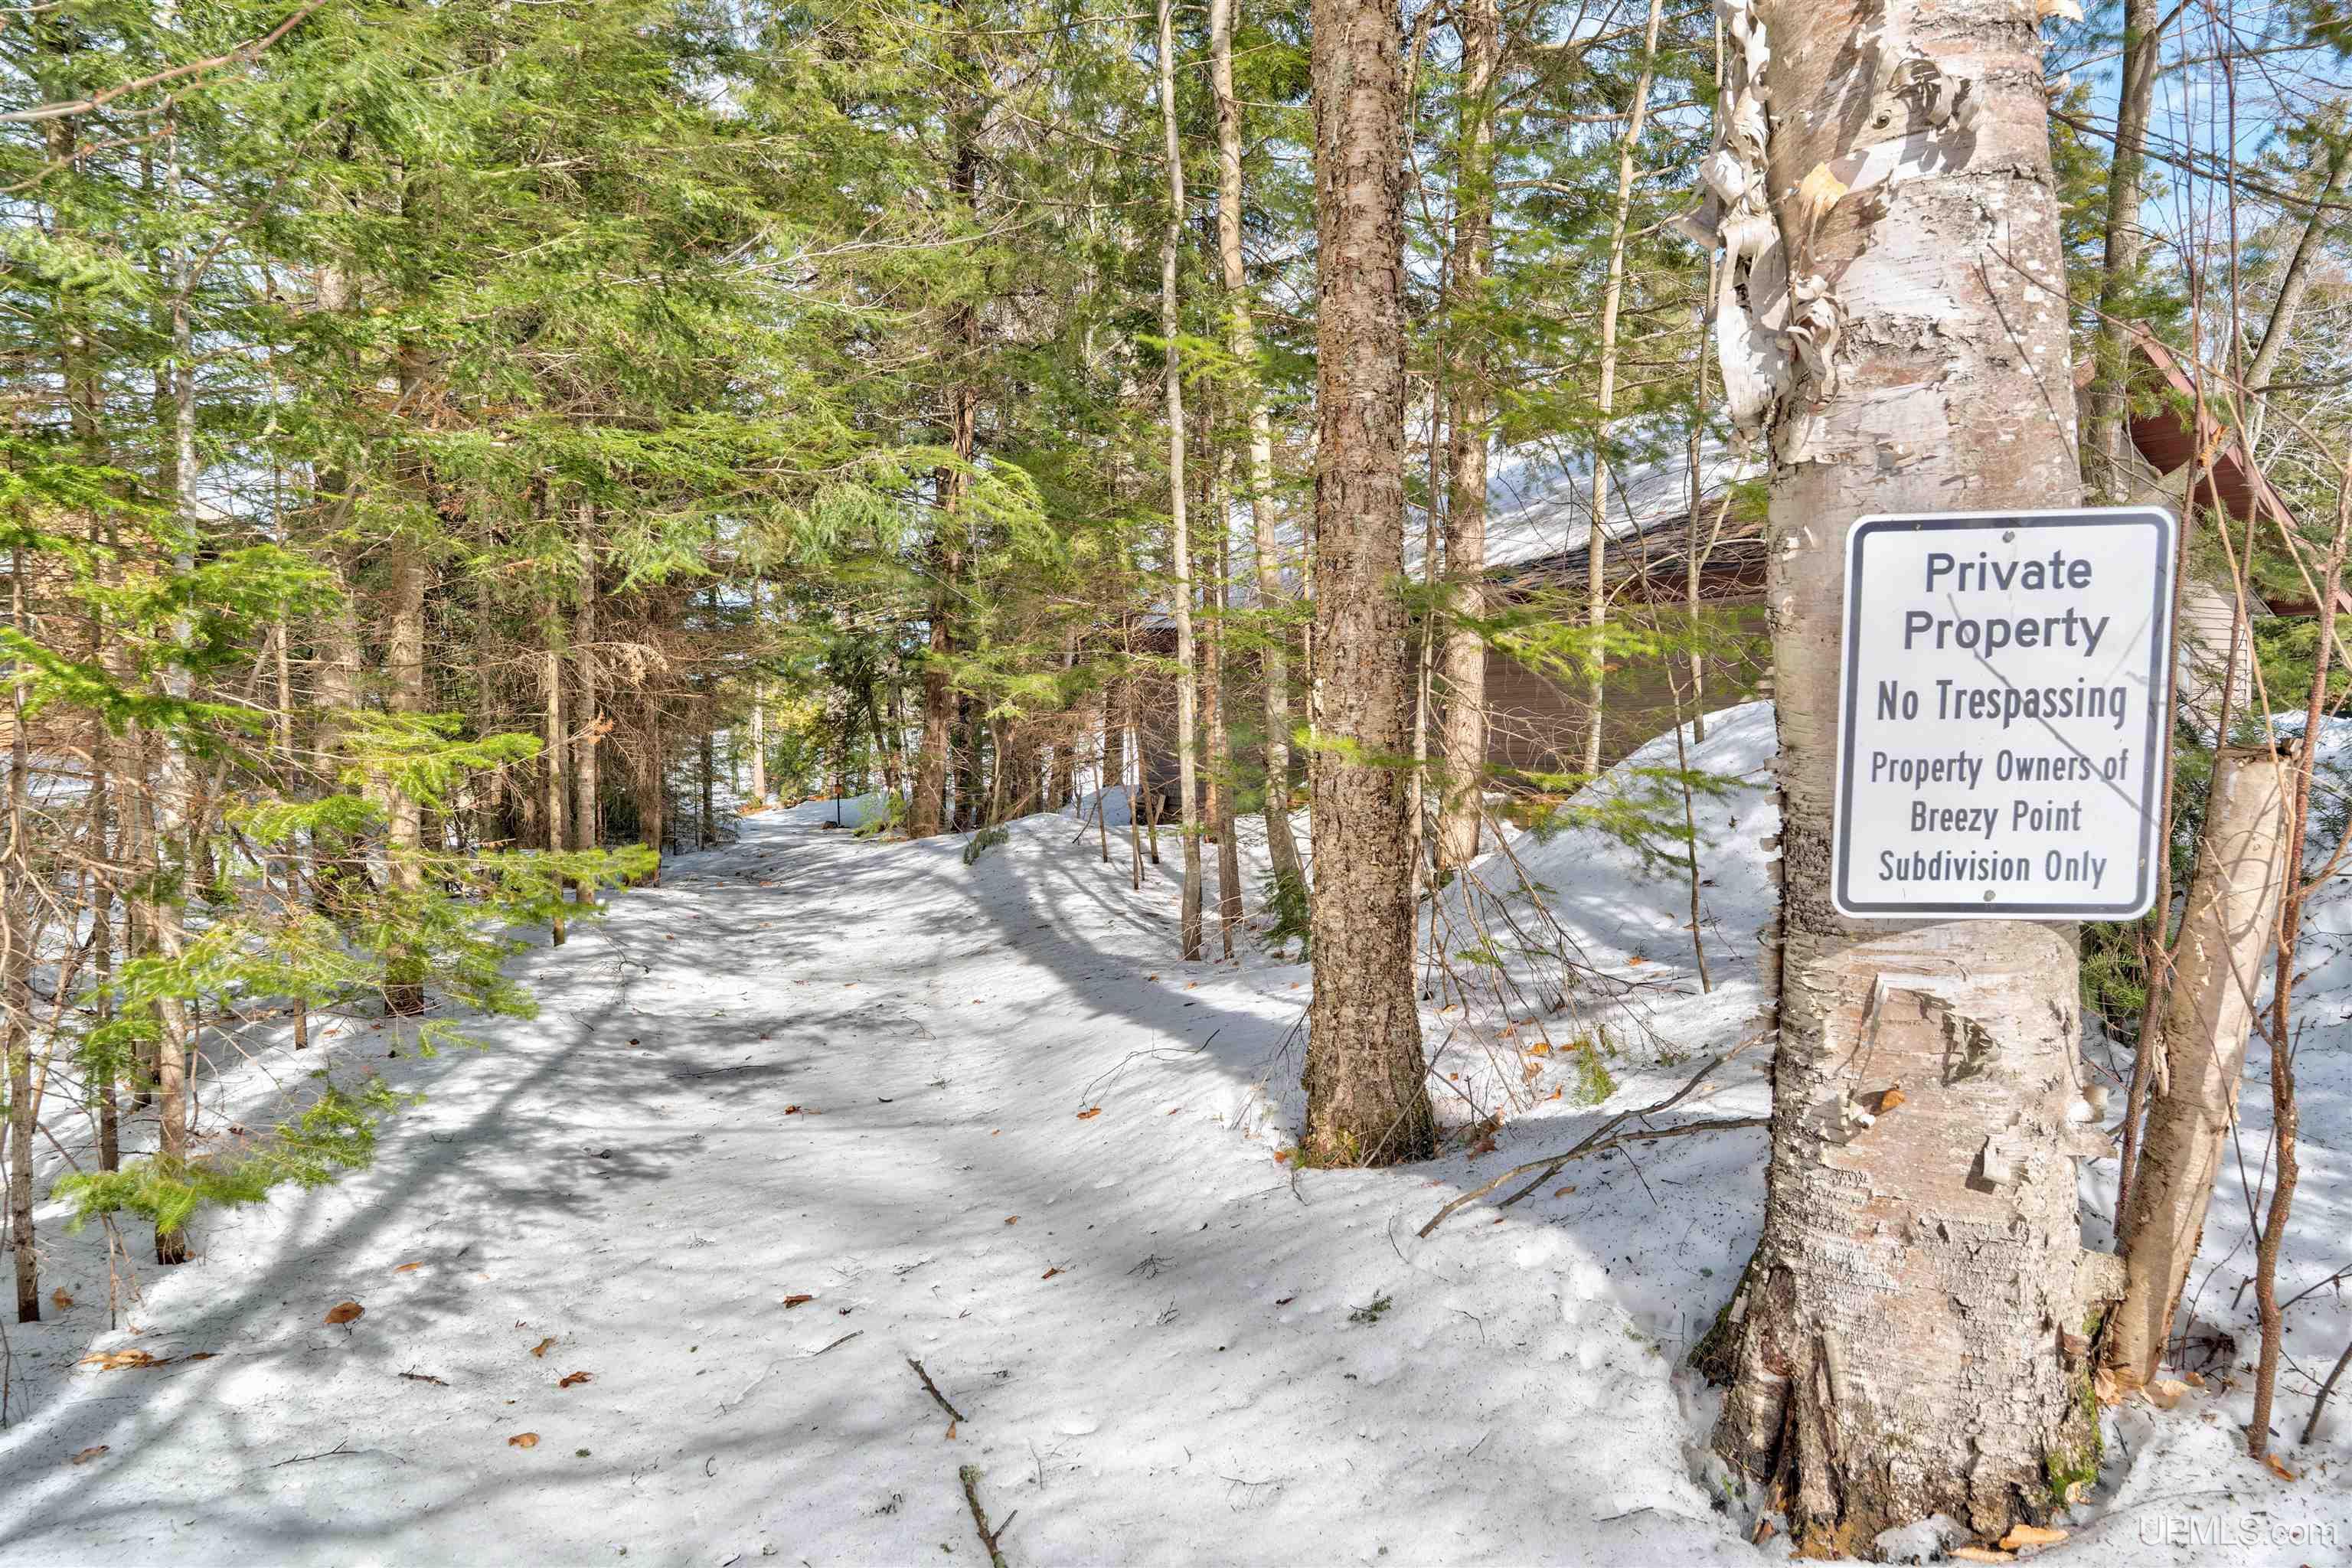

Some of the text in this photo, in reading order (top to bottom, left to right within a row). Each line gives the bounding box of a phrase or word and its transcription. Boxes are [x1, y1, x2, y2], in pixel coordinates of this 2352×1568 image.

[1926, 550, 2092, 593] Private
[1904, 607, 2110, 658] Property
[1877, 678, 2127, 730] No Trespassing
[1871, 748, 2129, 790] Property Owners of
[1910, 799, 2082, 839] Breezy Point
[1878, 849, 2107, 890] Subdivision Only
